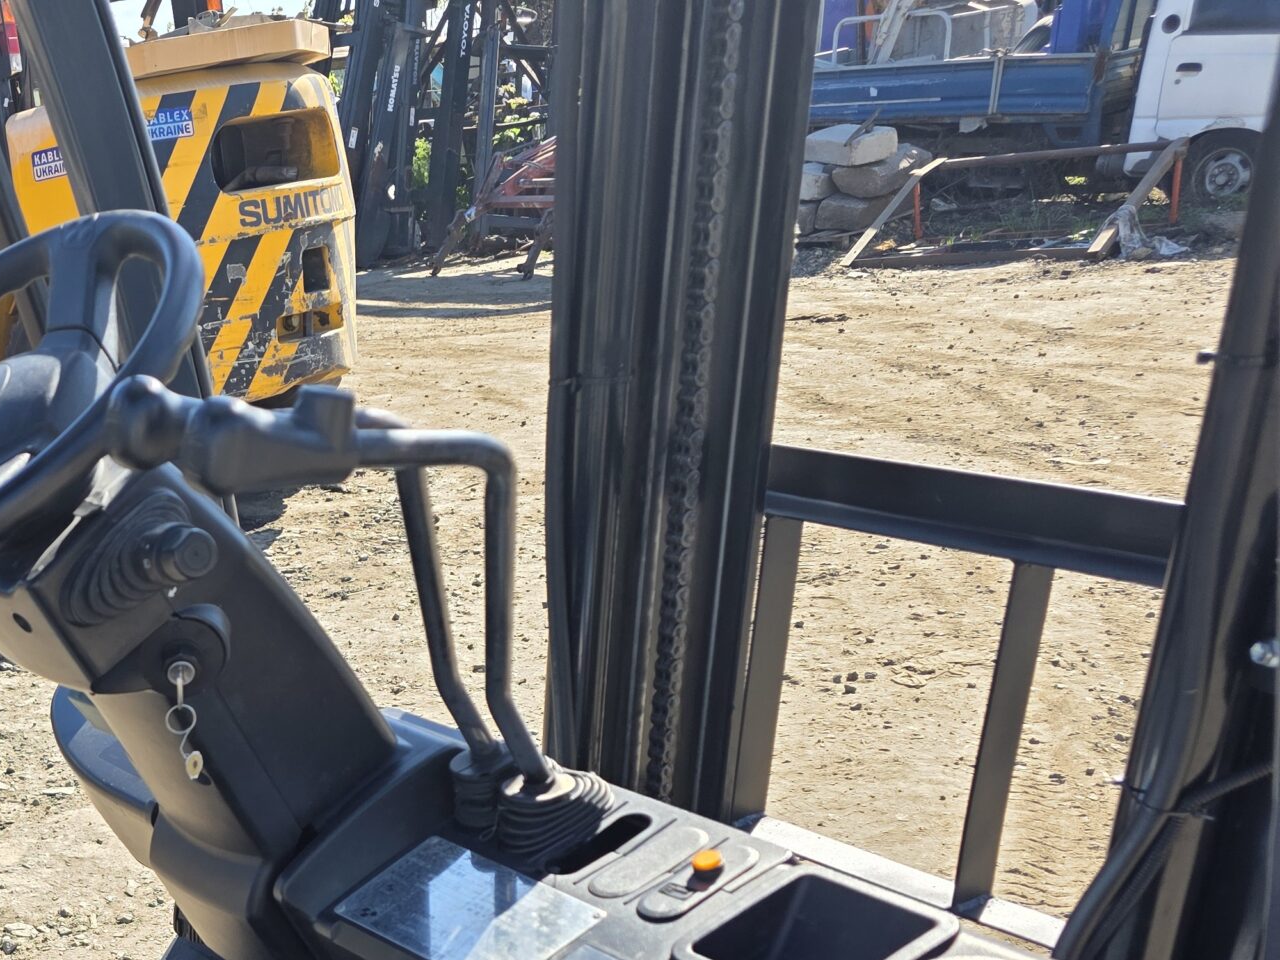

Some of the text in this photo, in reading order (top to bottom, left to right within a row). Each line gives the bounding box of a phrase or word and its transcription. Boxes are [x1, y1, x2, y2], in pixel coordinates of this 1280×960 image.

[460, 3, 471, 58] TOYOTA
[387, 64, 401, 113] KOMATSU
[145, 109, 190, 126] ABLEX
[33, 149, 63, 166] KABL
[35, 161, 66, 178] UKRAI
